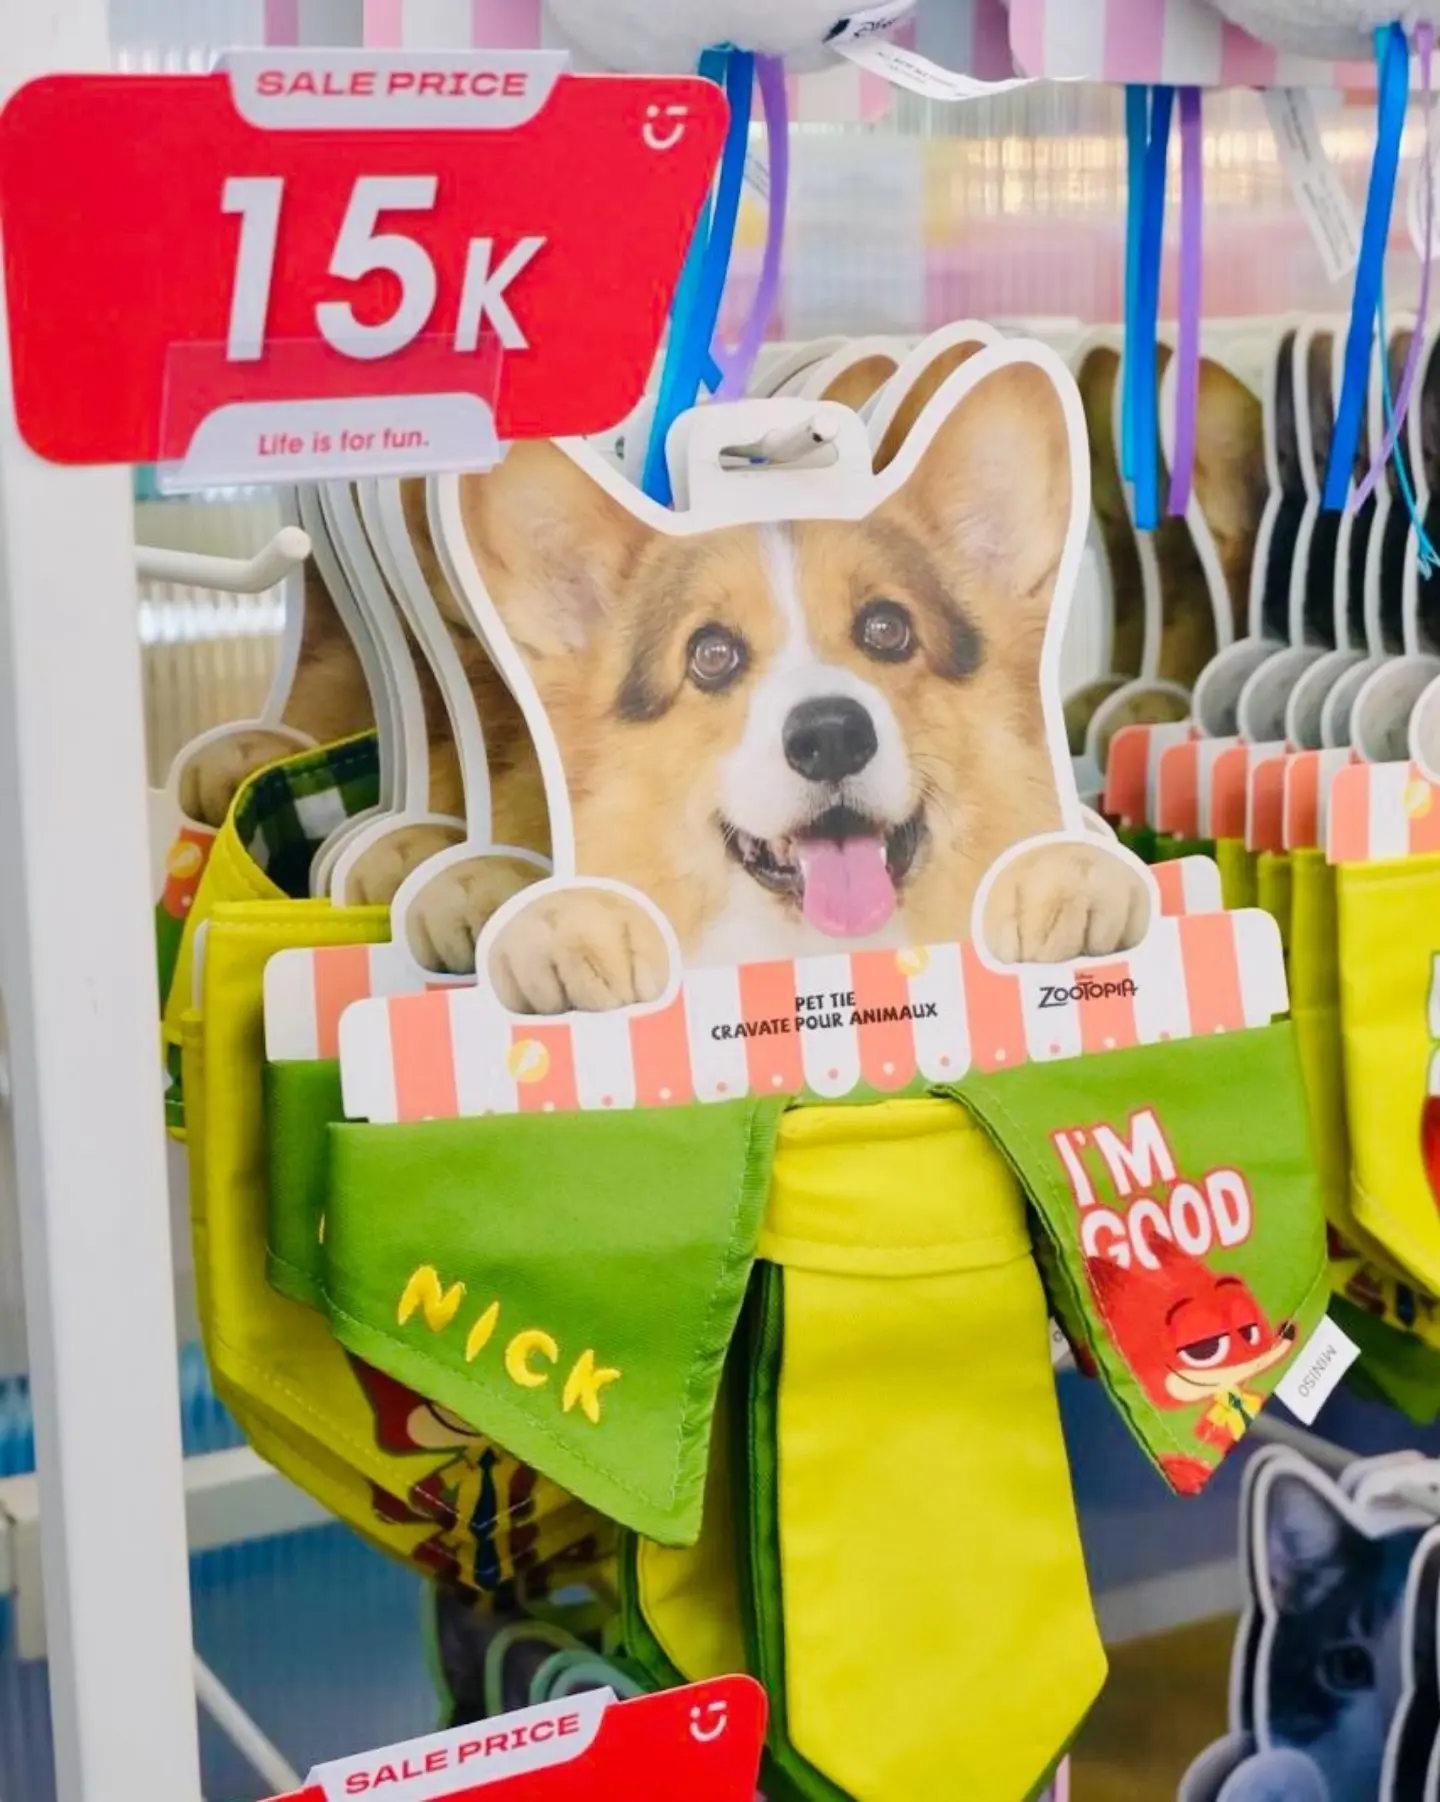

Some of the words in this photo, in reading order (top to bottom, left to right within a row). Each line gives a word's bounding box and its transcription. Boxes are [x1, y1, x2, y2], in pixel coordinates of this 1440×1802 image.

[256, 71, 377, 97] SALE
[388, 71, 529, 98] PRICE
[258, 433, 304, 456] Life
[313, 431, 331, 452] is
[340, 429, 375, 451] for
[383, 427, 430, 449] fun.
[795, 995, 824, 1012] PET
[830, 991, 856, 1008] TIE
[1038, 978, 1138, 1008] ZOOTOPIA
[711, 1017, 790, 1040] CRAVATE
[795, 1012, 842, 1032] POUR
[849, 1002, 938, 1025] ANIMAUX
[1053, 1108, 1177, 1207] I'M
[1081, 1169, 1250, 1271] GOOD
[397, 1264, 621, 1425] NICK
[1298, 1344, 1337, 1397] MINISO
[346, 1749, 448, 1794] SALE
[458, 1713, 580, 1764] PRICE
